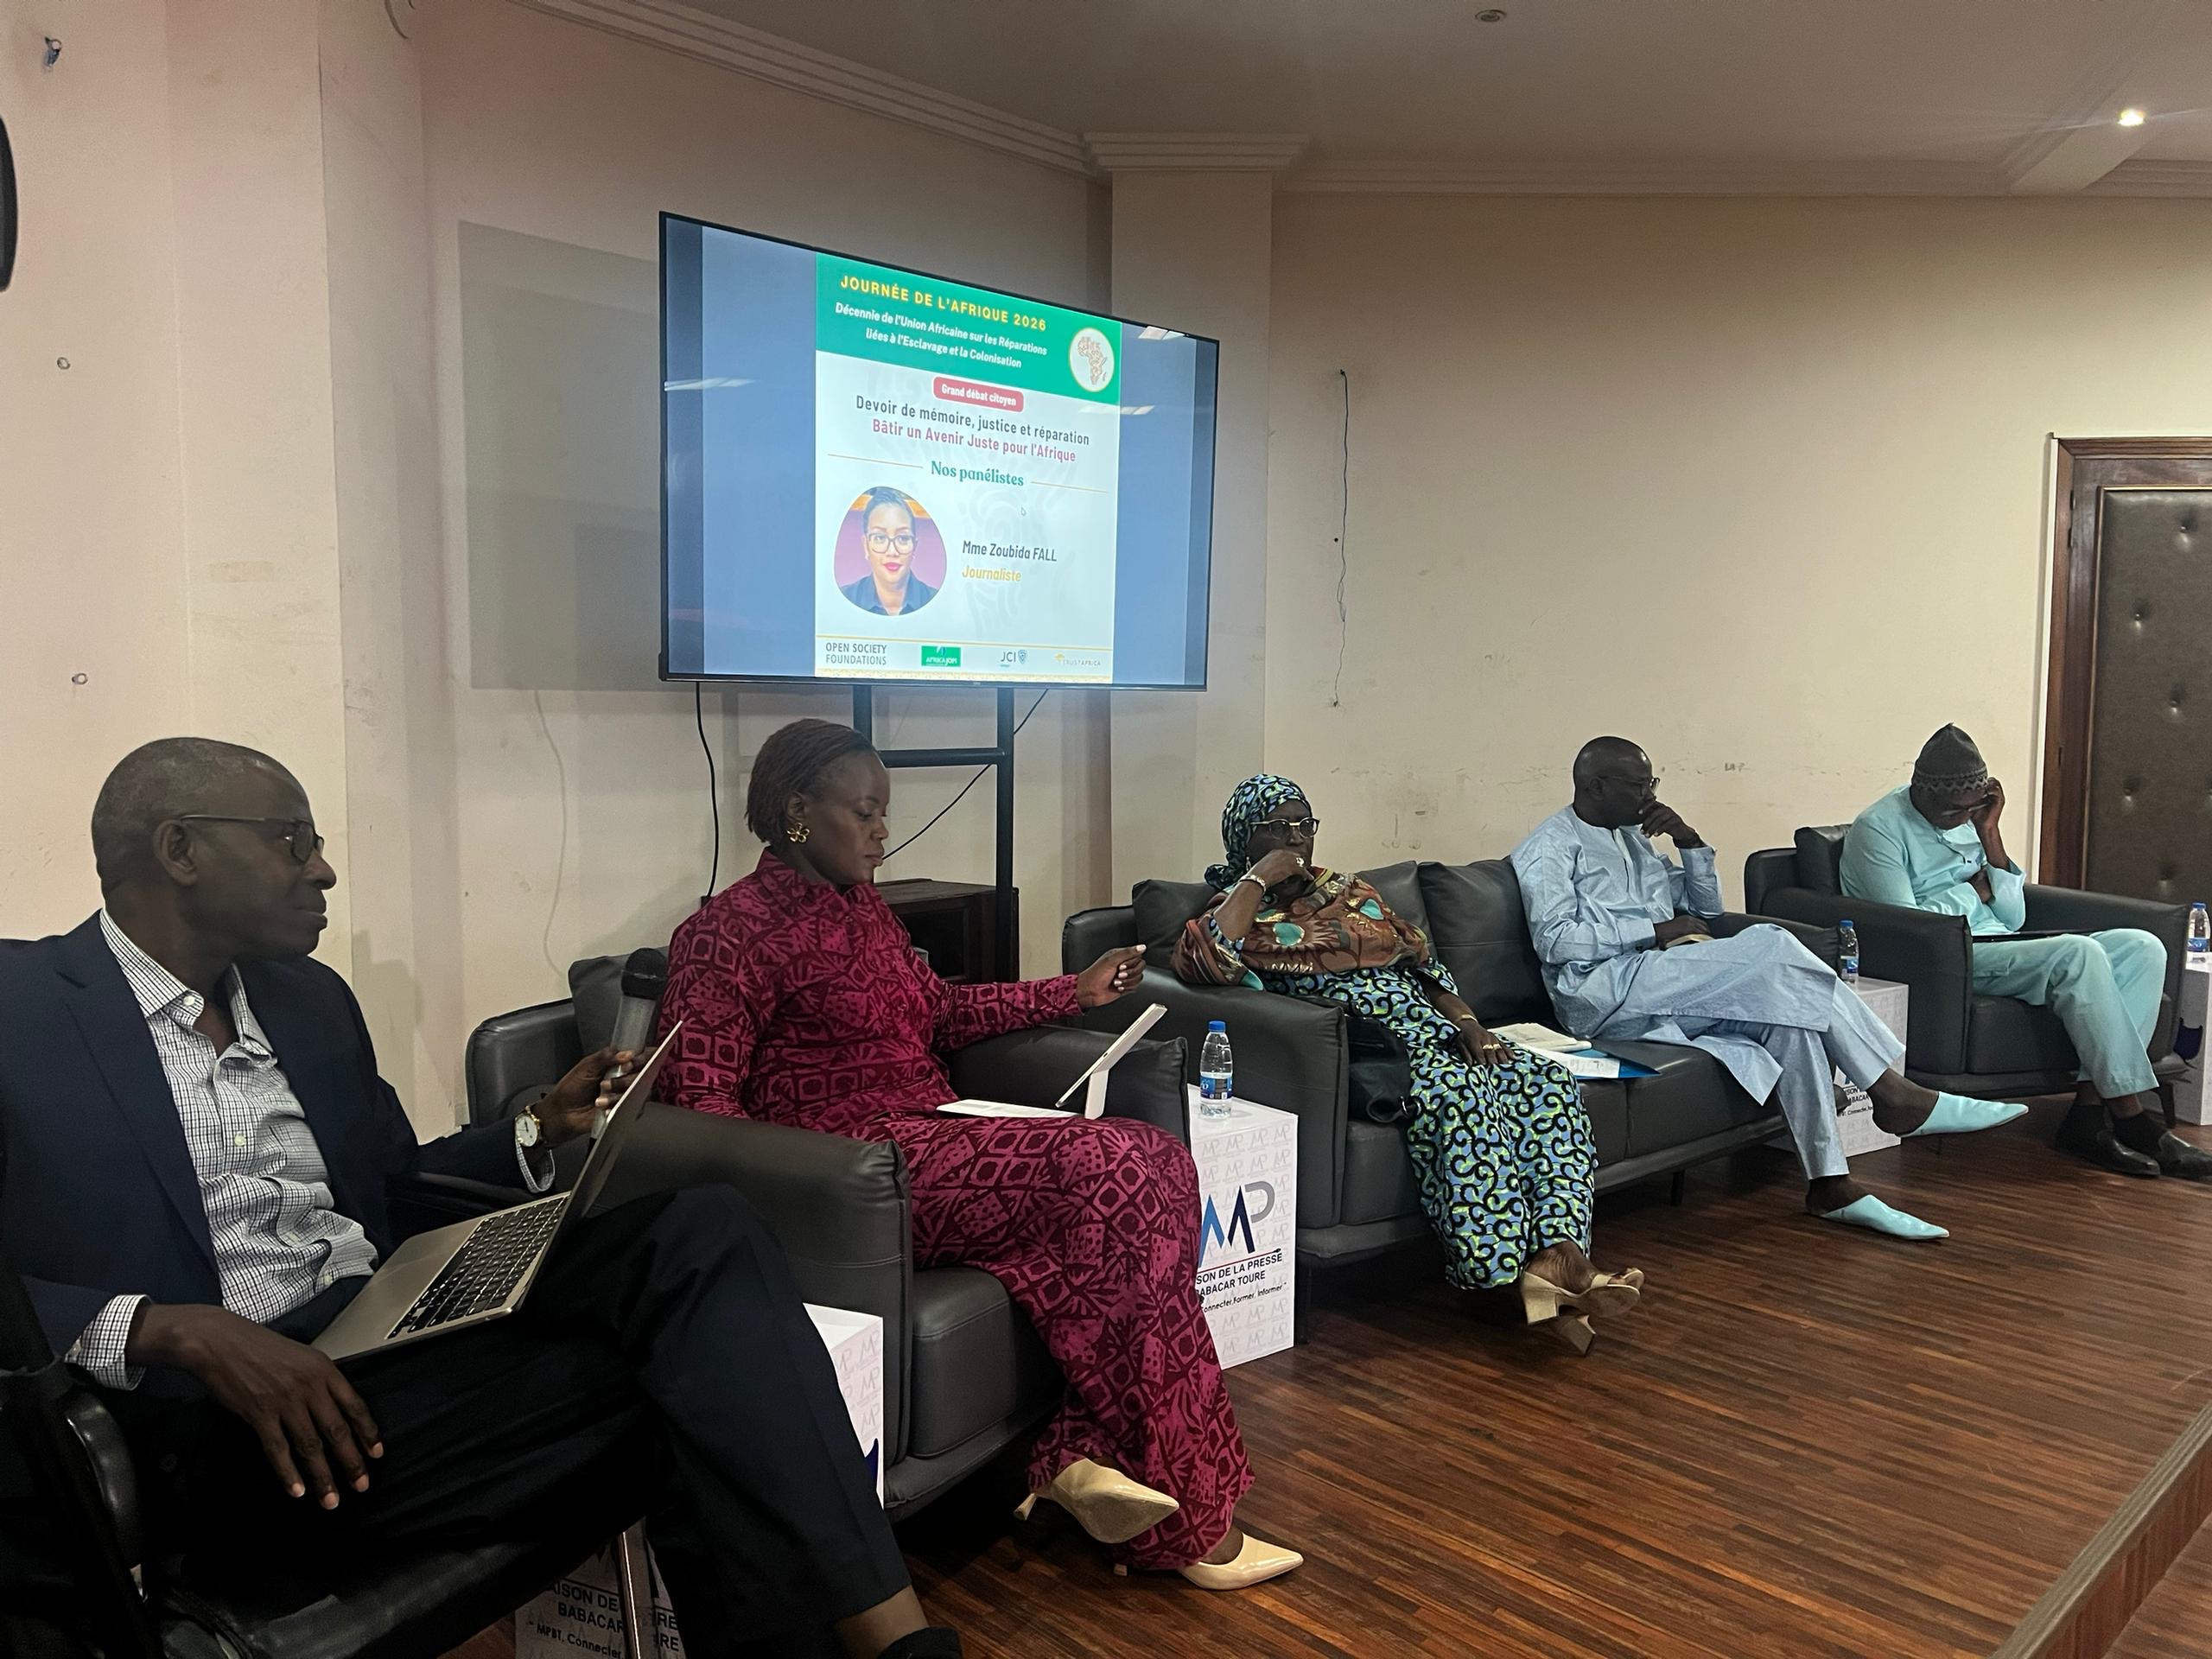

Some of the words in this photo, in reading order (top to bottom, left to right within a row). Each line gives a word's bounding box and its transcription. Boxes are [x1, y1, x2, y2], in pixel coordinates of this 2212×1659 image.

[841, 275, 909, 302] JOURNÉE
[914, 291, 933, 307] DE
[938, 296, 1009, 323] L'AFRIQUE
[1014, 313, 1046, 331] 2026
[835, 302, 880, 321] Décennie
[881, 312, 894, 324] de
[894, 314, 927, 332] l'Union
[928, 321, 969, 340] Africaine
[969, 332, 983, 343] sur
[985, 333, 997, 346] les
[999, 336, 1048, 356] Réparations
[866, 327, 889, 343] liées
[889, 333, 897, 344] à
[898, 334, 948, 355] l'Esclavage
[949, 346, 958, 356] et
[959, 346, 969, 358] la
[969, 348, 1022, 368] Colonisation
[941, 384, 965, 397] Grand
[966, 388, 988, 402] débat
[988, 392, 1017, 407] citoyen
[856, 395, 898, 415] Devoir
[901, 403, 916, 417] de
[919, 408, 975, 429] mémoire,
[977, 415, 1017, 434] justice
[1020, 424, 1032, 435] et
[1034, 426, 1090, 446] réparation
[873, 418, 904, 436] Bâtir
[907, 427, 922, 439] un
[925, 427, 964, 445] Avenir
[968, 434, 1000, 450] Juste
[1003, 442, 1028, 455] pour
[1031, 443, 1076, 463] l'Afrique
[931, 461, 957, 477] Nos
[959, 467, 1024, 486] panélistes
[963, 540, 988, 556] Mme
[989, 543, 1031, 560] Zoubida
[1033, 547, 1057, 563] FALL
[962, 564, 1021, 582] Journaliste
[825, 642, 849, 653] OPEN
[853, 643, 887, 654] SOCIETY
[825, 653, 887, 665] FOUNDATIONS
[1000, 652, 1016, 663] JCI
[1196, 1271, 1217, 1285] SON
[1218, 1267, 1231, 1279] DE
[1234, 1262, 1245, 1274] LA
[1248, 1253, 1283, 1271] PRESSE
[1238, 1270, 1266, 1287] TOURE
[552, 1582, 593, 1605] ISON
[598, 1593, 619, 1613] DE
